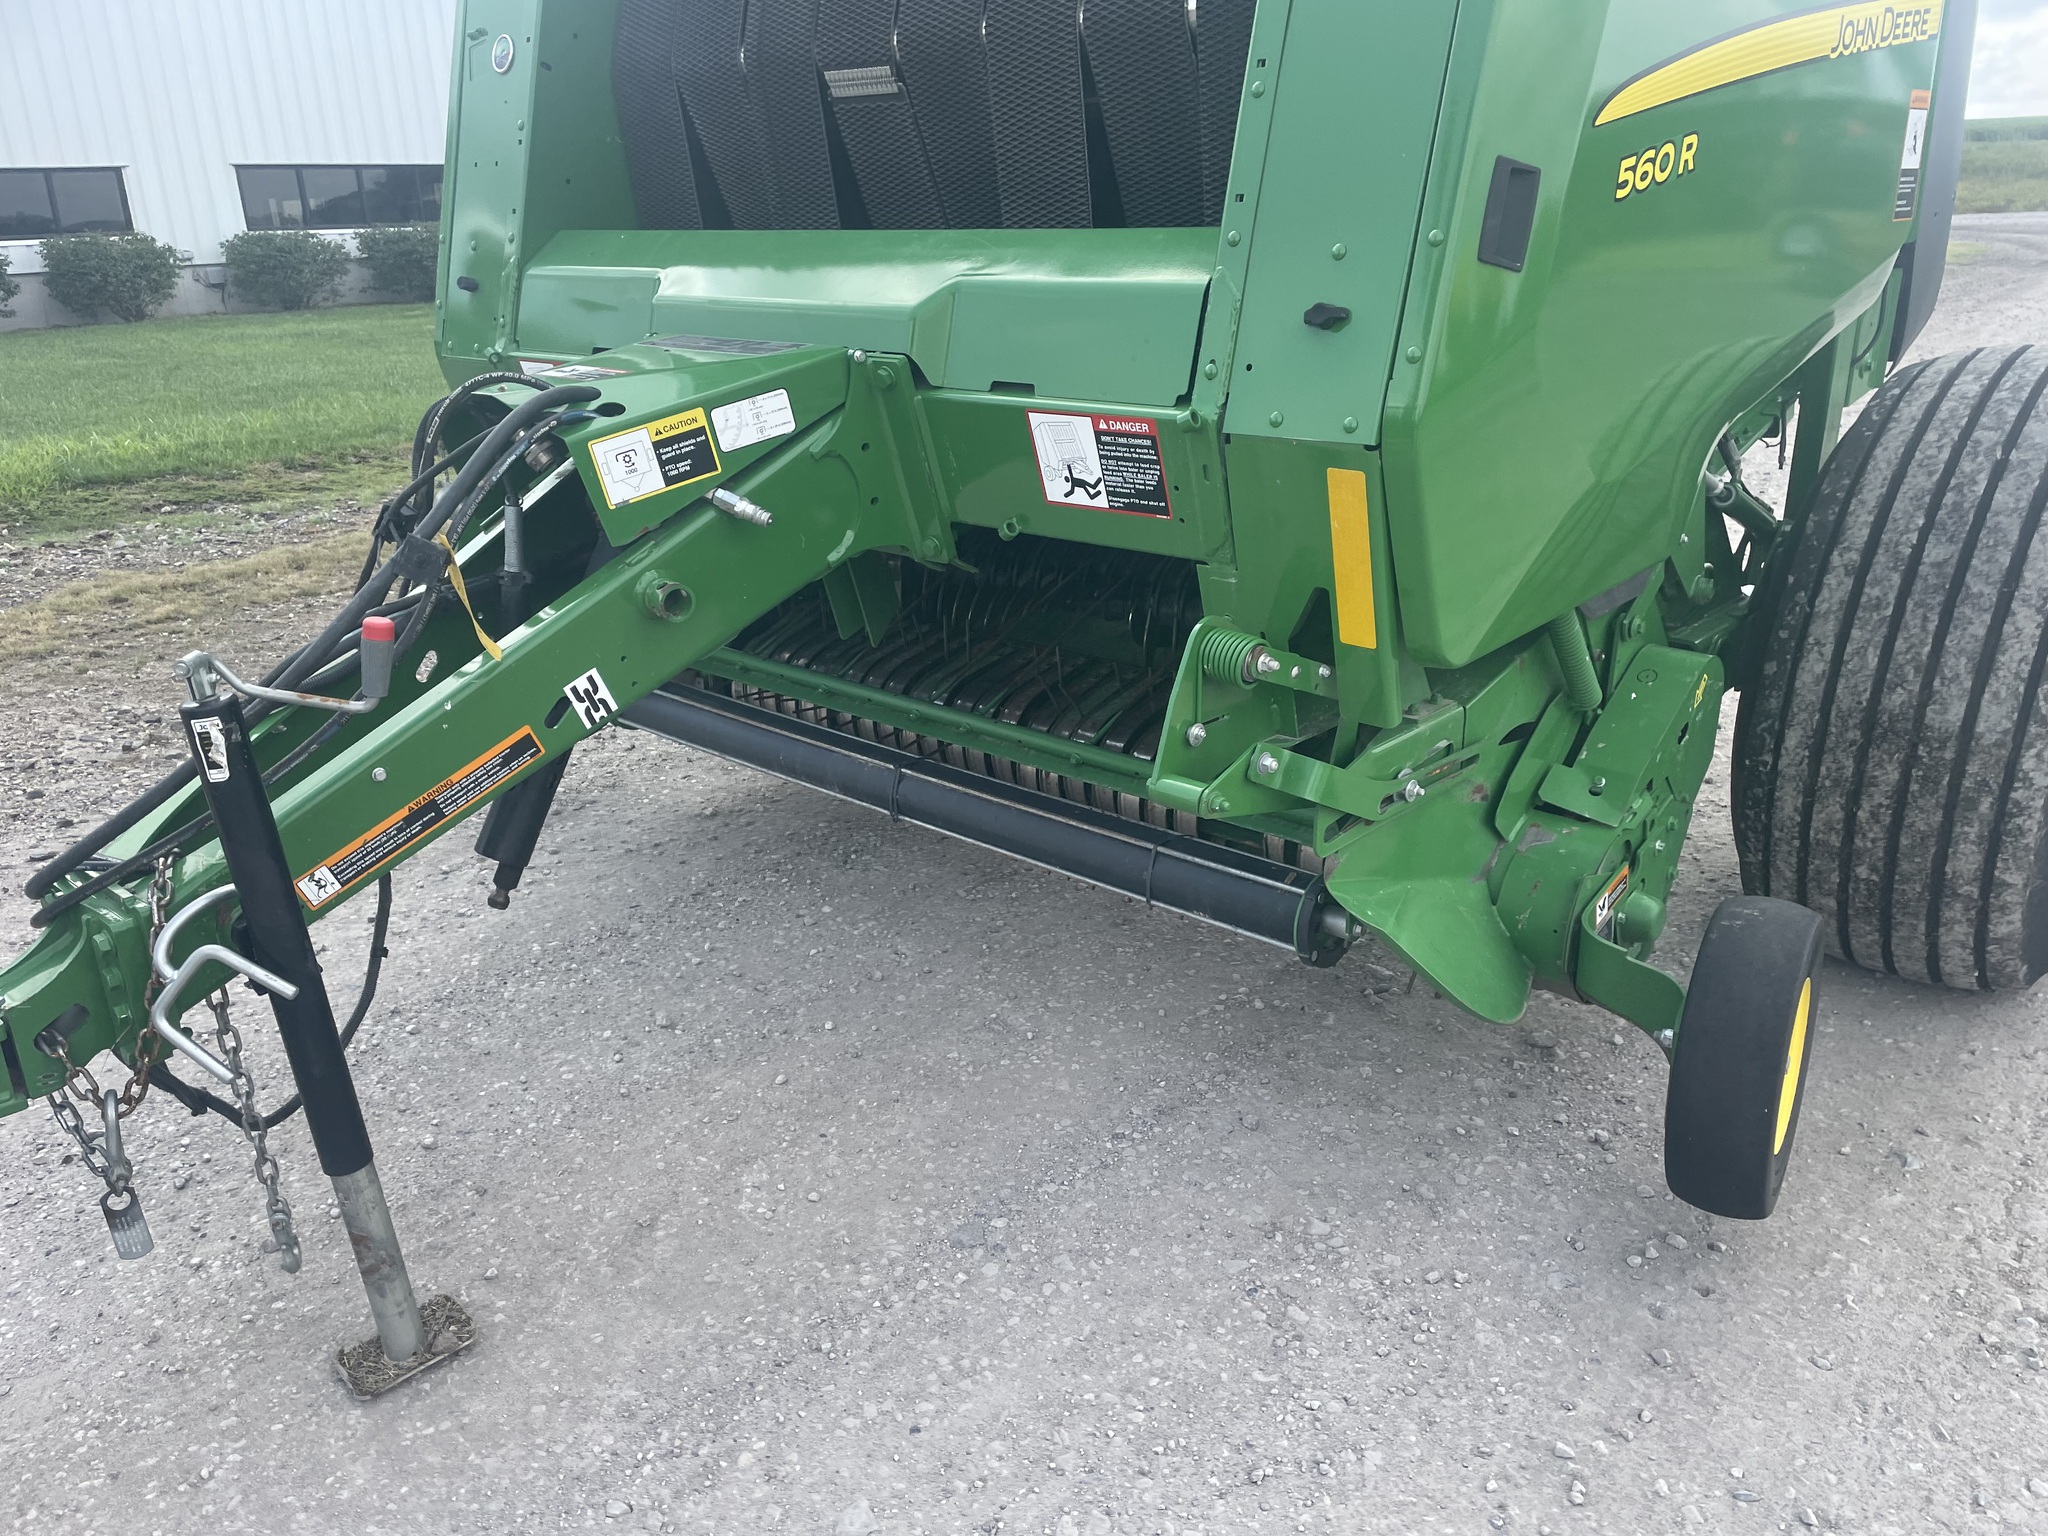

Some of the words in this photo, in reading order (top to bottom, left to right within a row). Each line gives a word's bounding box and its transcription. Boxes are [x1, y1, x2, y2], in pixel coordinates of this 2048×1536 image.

[1830, 14, 1879, 54] JOHN
[1880, 6, 1931, 44] DEERE
[520, 374, 536, 382] MPa
[663, 417, 697, 432] CAUTION
[1109, 421, 1149, 432] DANGER
[660, 446, 672, 454] Keep
[679, 438, 696, 448] shields
[696, 434, 706, 442] and
[681, 446, 696, 454] place.
[624, 466, 638, 476] 1000
[676, 459, 692, 468] speed:
[679, 465, 690, 473] RPM
[470, 767, 484, 777] properly
[484, 756, 499, 768] ballasted
[499, 749, 510, 757] tractor
[413, 779, 453, 807] WARNING
[443, 803, 456, 812] Reduce
[456, 795, 467, 803] speed
[480, 775, 496, 787] additional
[497, 766, 509, 775] caution
[447, 787, 461, 797] properly
[462, 776, 476, 787] attached
[452, 788, 467, 800] transport
[467, 790, 480, 800] adverse
[481, 782, 493, 791] surface
[383, 843, 396, 853] serious
[396, 836, 406, 844] injury
[334, 861, 351, 874] transport
[352, 853, 362, 862] speed
[338, 865, 357, 878] Exceeding
[364, 852, 375, 860] speed
[344, 852, 357, 862] exceed
